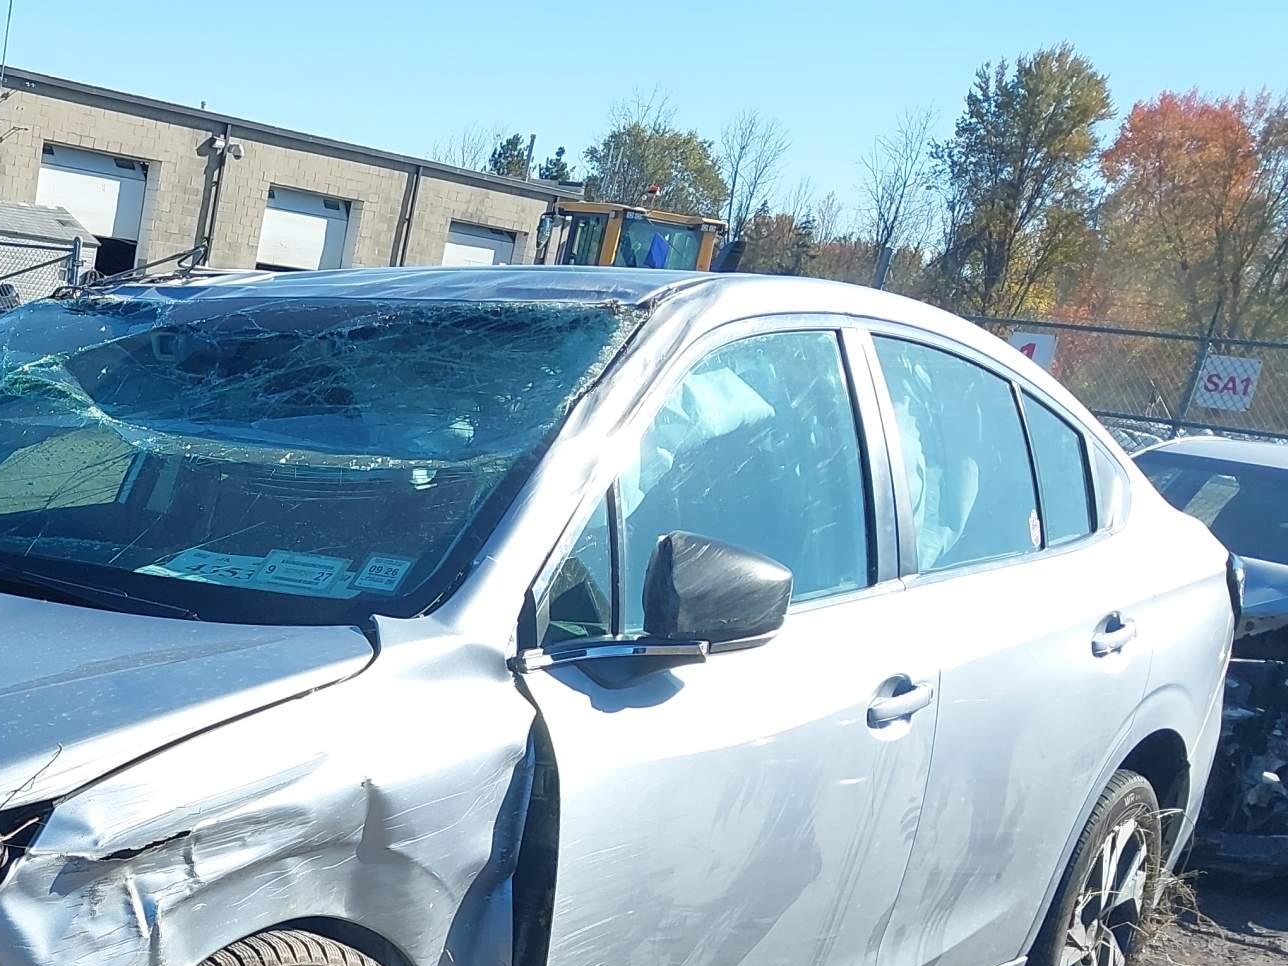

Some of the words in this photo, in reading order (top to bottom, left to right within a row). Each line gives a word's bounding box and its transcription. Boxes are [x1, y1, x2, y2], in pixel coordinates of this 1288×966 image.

[1204, 373, 1252, 396] SA1
[266, 564, 277, 574] 9
[313, 571, 334, 582] 27
